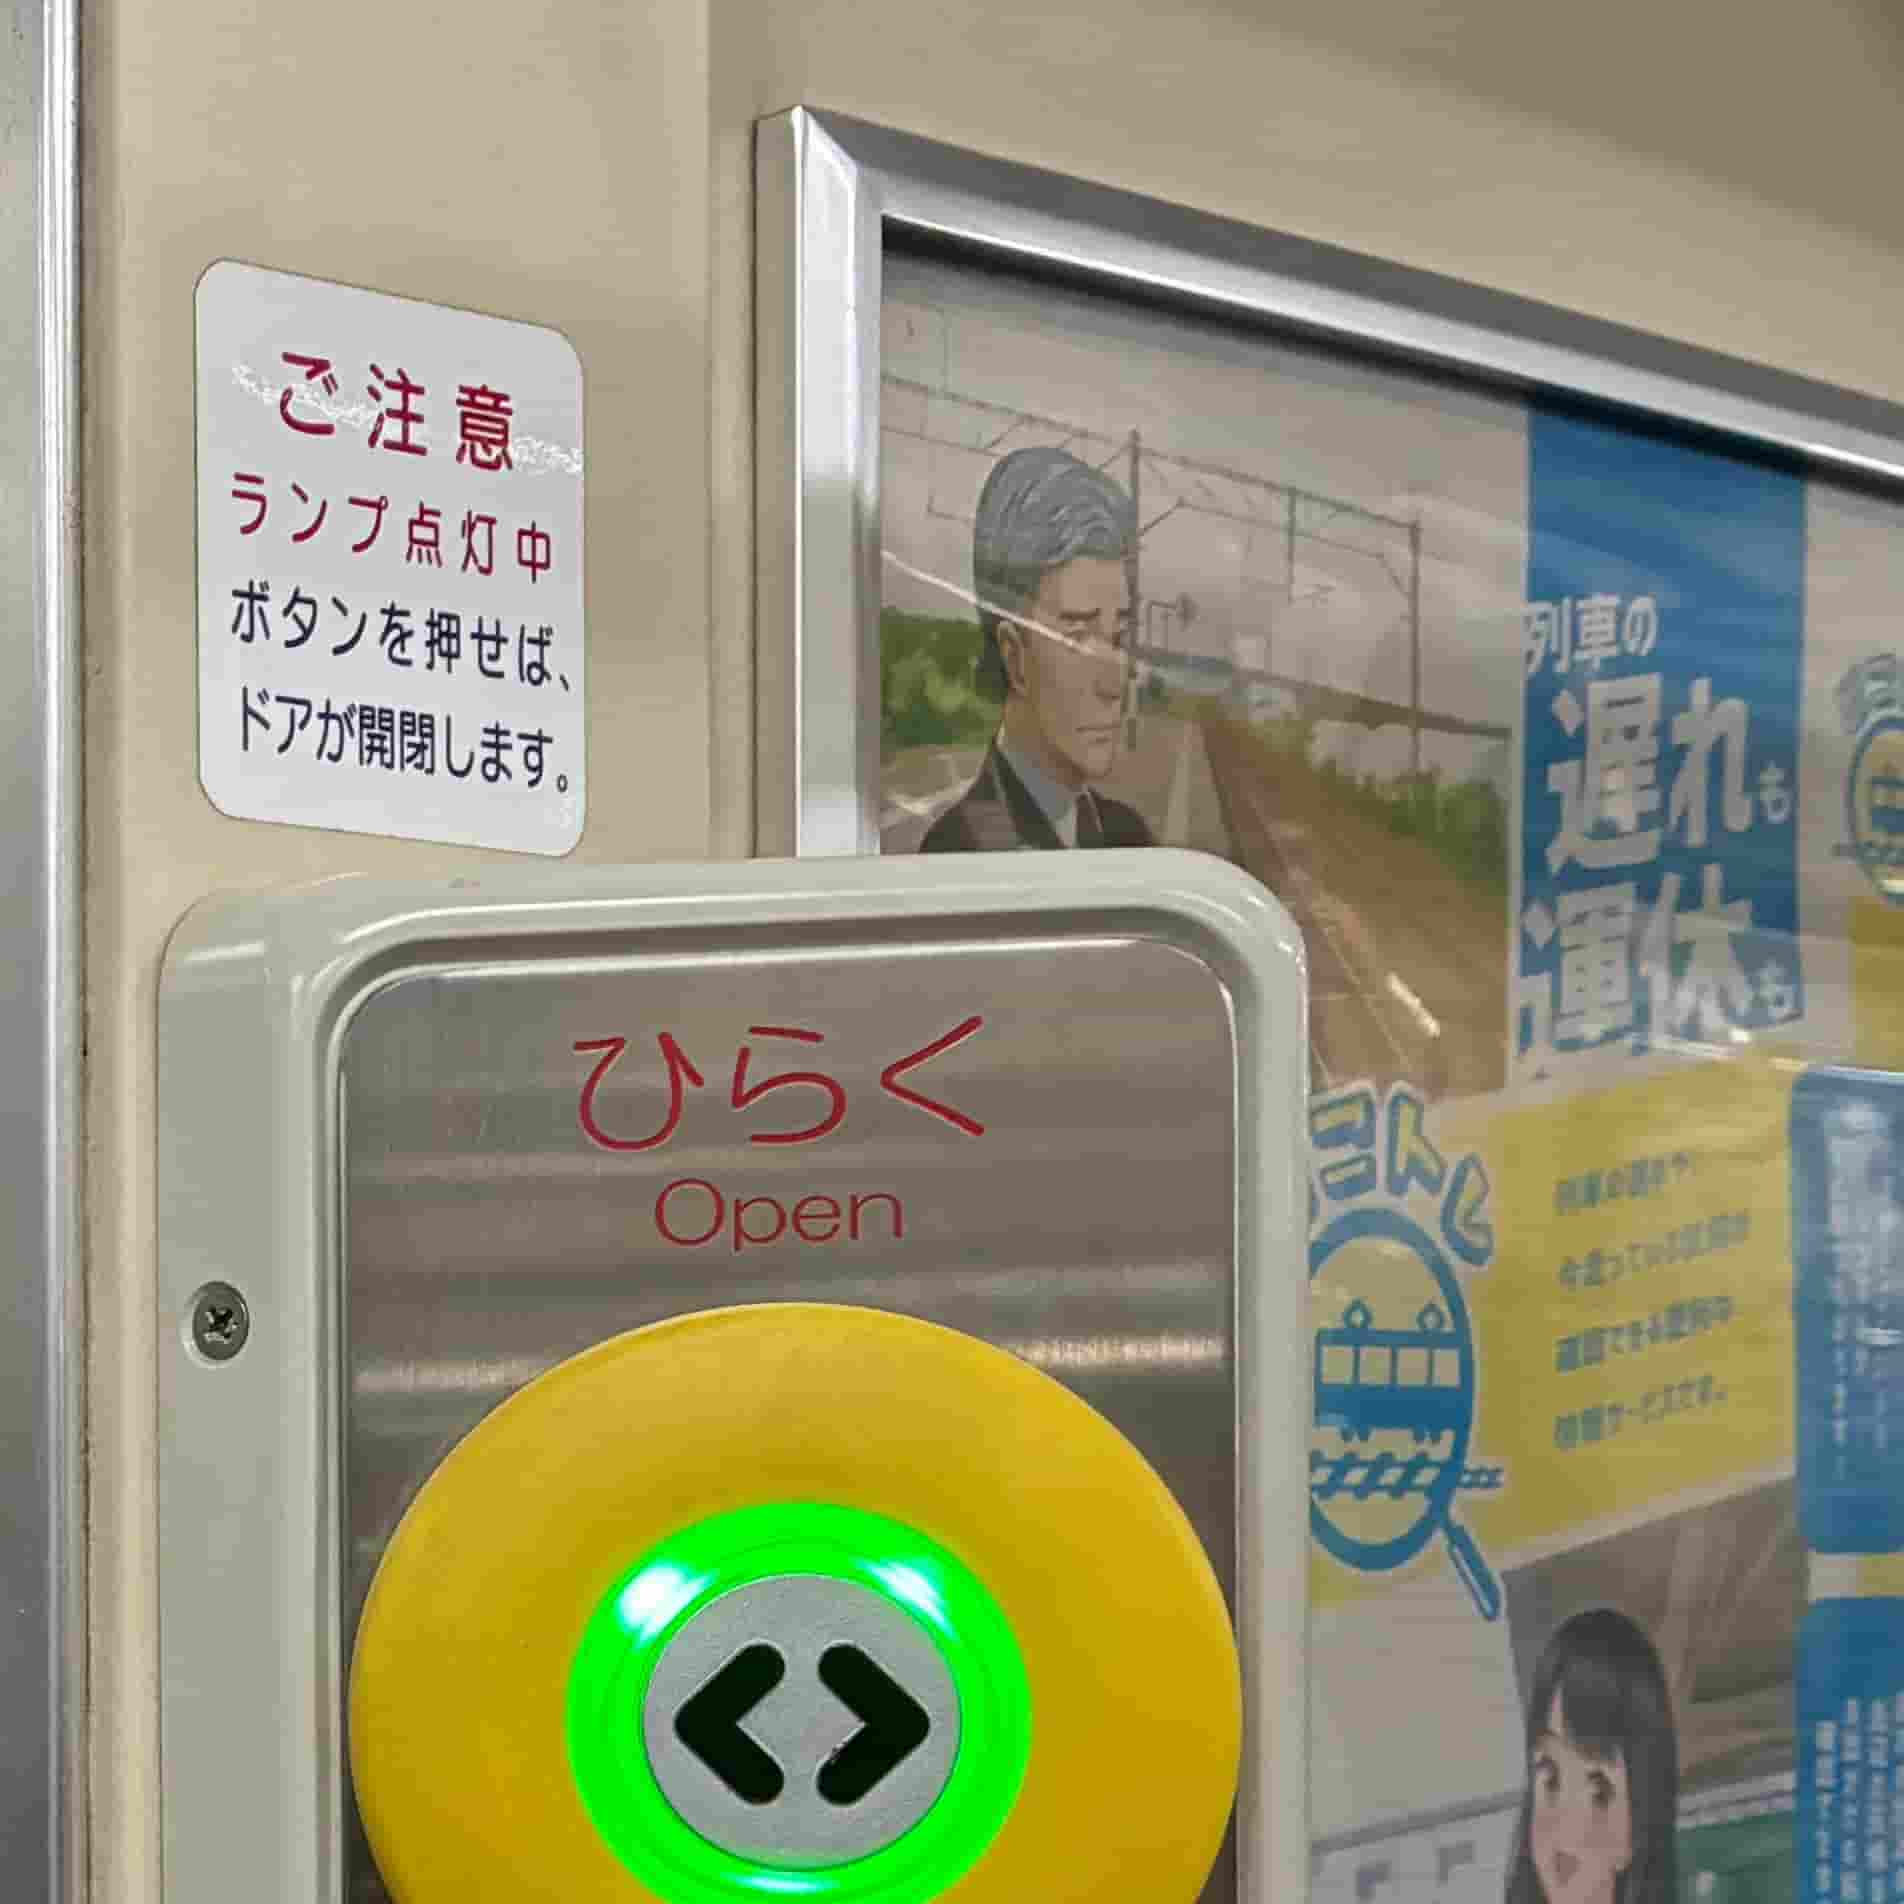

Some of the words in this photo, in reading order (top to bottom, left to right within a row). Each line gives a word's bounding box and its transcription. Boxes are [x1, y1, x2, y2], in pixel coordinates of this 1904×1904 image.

[279, 351, 513, 473] ご注意
[232, 472, 552, 584] ランプ点灯中
[232, 579, 571, 692] ボタンを押せば、
[1523, 594, 1659, 675] 列車の
[242, 685, 570, 794] ドアが開閉します。
[572, 1015, 985, 1152] ひらく
[654, 1177, 905, 1254] Open
